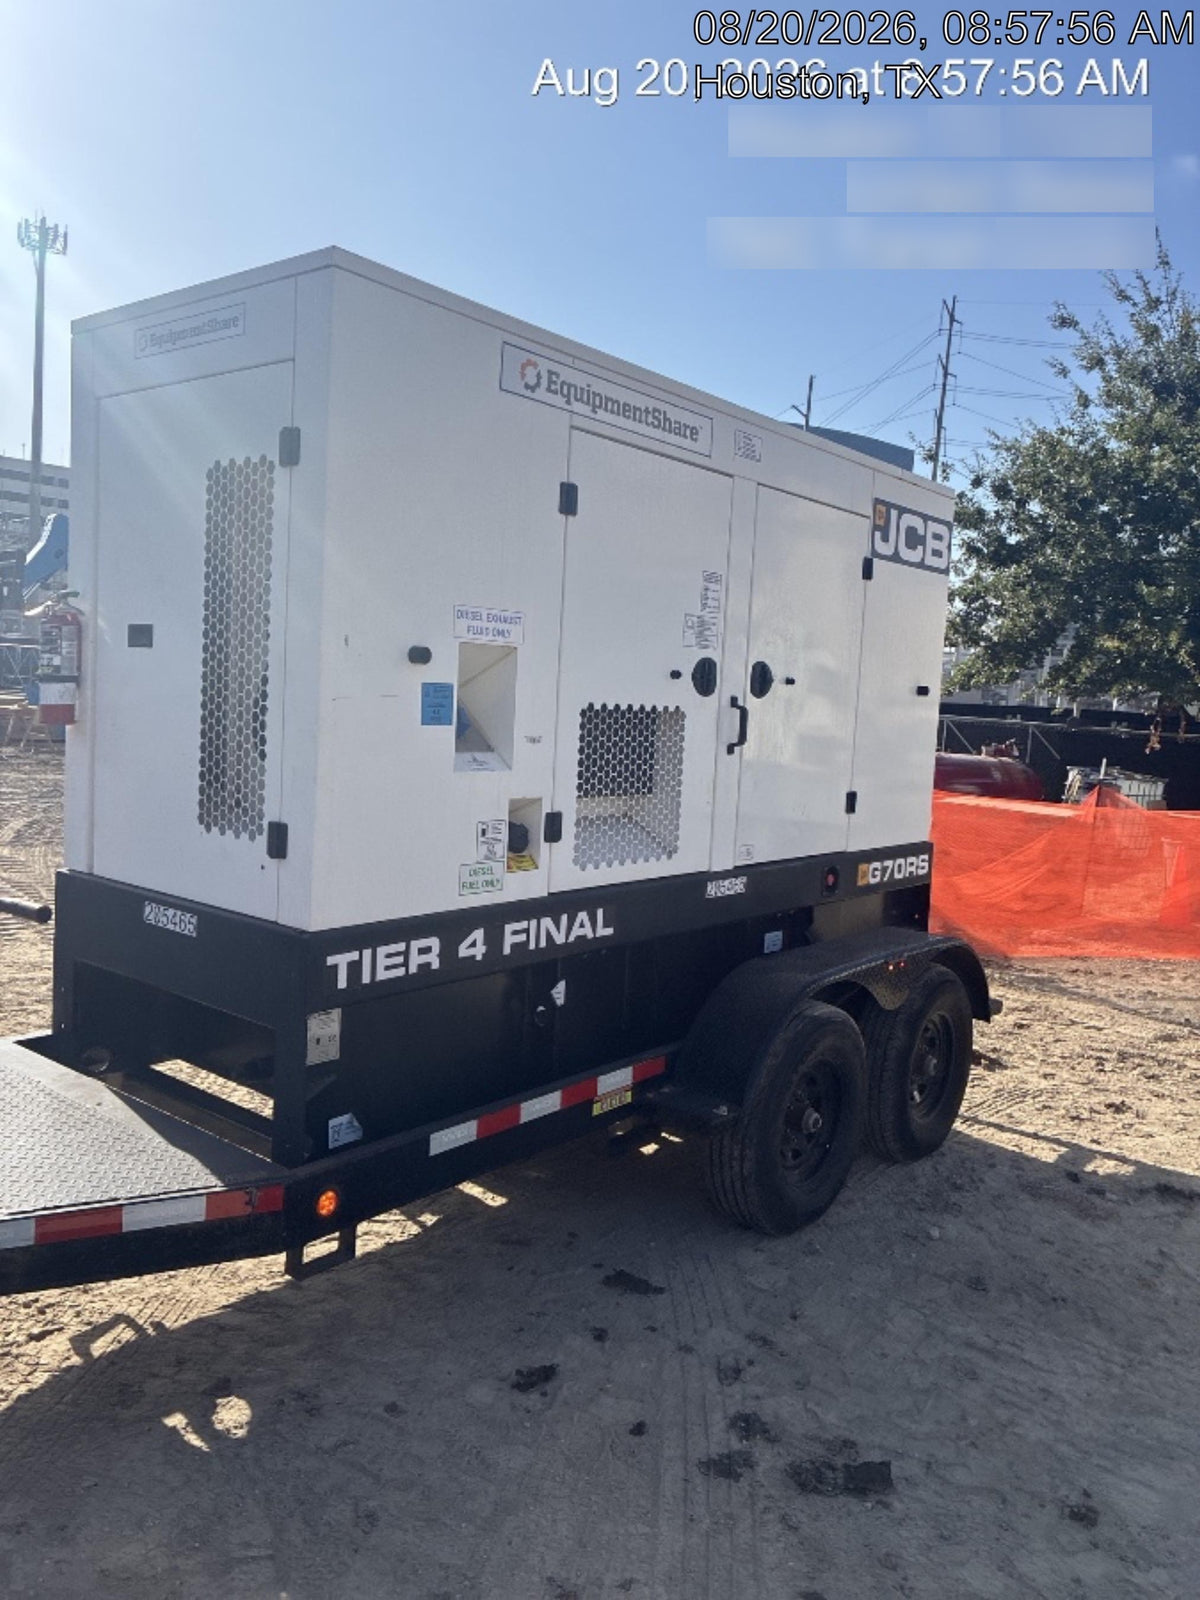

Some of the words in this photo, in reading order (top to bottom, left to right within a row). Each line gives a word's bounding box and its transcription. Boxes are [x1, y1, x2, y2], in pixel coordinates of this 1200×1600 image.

[545, 369, 700, 442] EquipmentShare
[873, 507, 951, 570] JCB
[868, 854, 929, 884] G70RS
[326, 936, 441, 990] TIER
[458, 927, 487, 962] 4
[503, 907, 615, 956] FINAL
